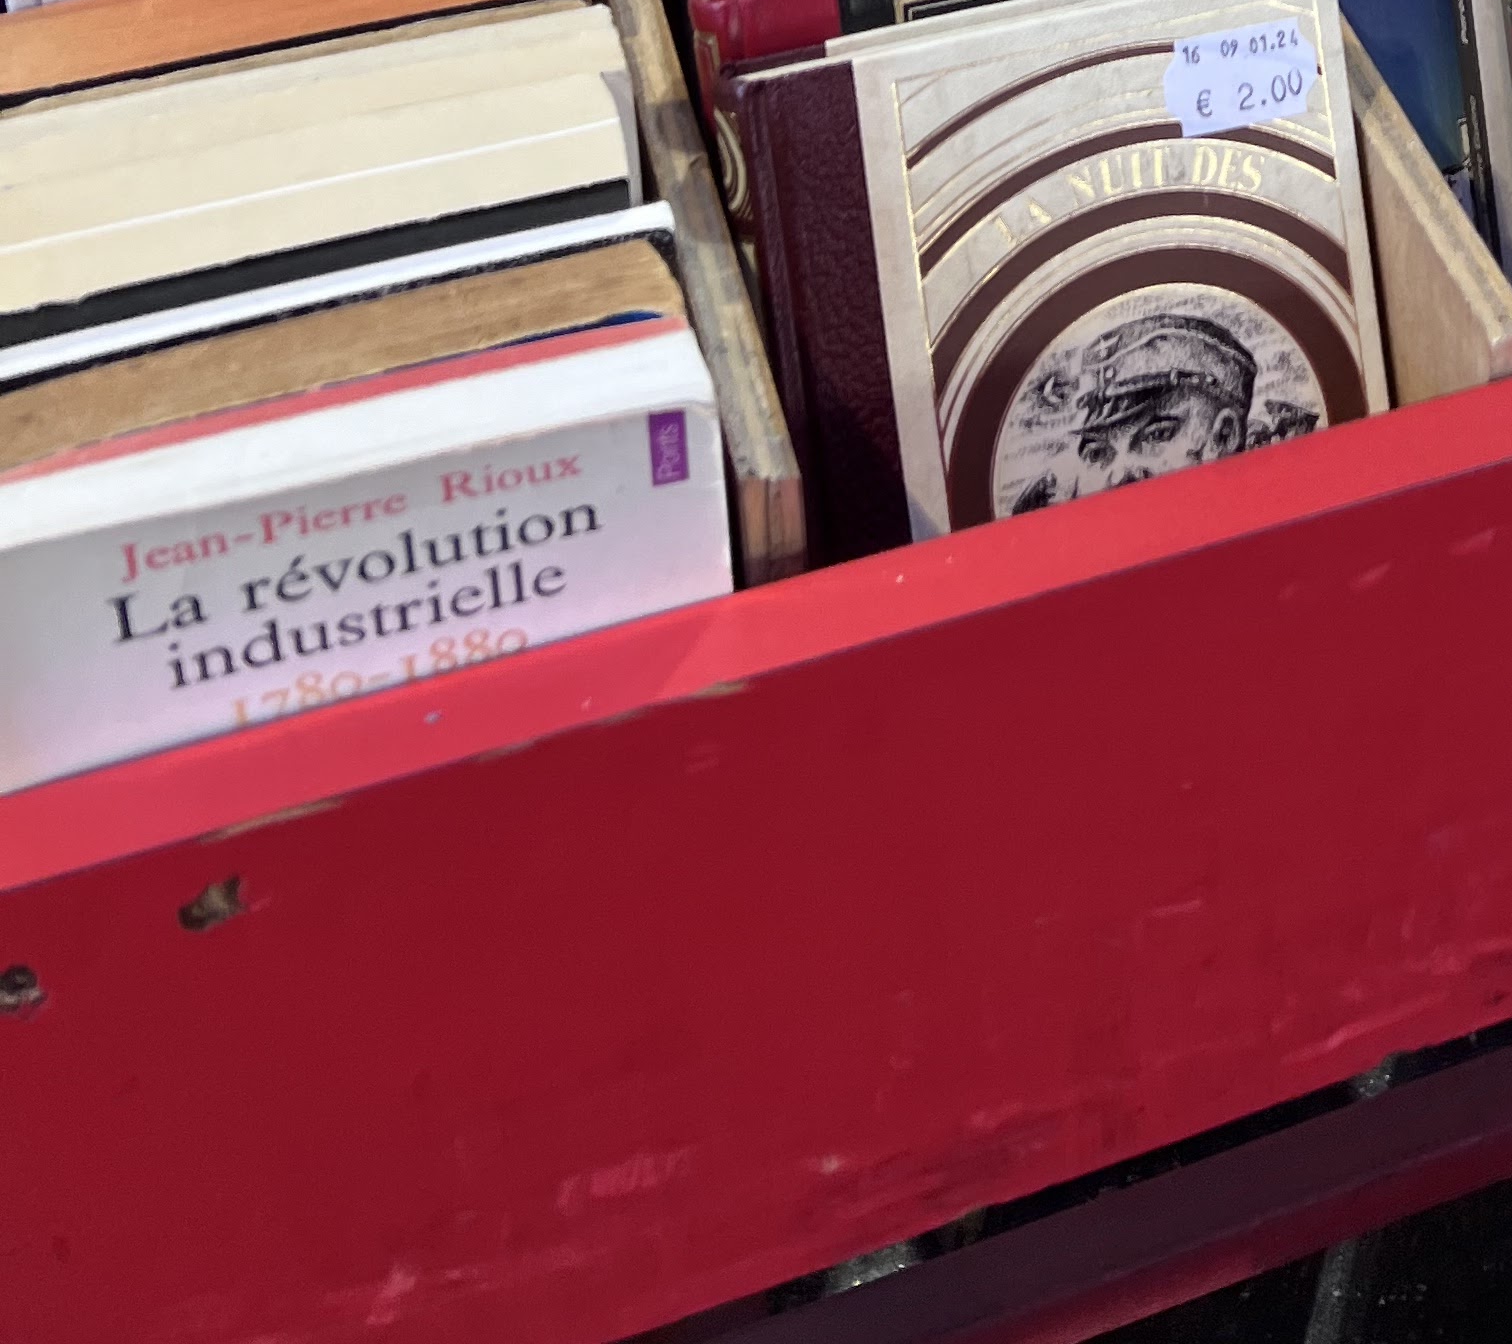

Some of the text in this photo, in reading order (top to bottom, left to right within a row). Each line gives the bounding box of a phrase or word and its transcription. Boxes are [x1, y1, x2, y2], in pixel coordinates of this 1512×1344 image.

[1182, 29, 1298, 64] 16 09 01.24
[1196, 67, 1303, 117] € 2.00
[1066, 147, 1171, 207] NUIT
[1191, 145, 1265, 193] DES
[120, 453, 582, 583] Jean-Pierre Rioux
[110, 501, 605, 644] La révolution
[168, 560, 567, 689] industrielle
[234, 626, 531, 728] 1780-1880
